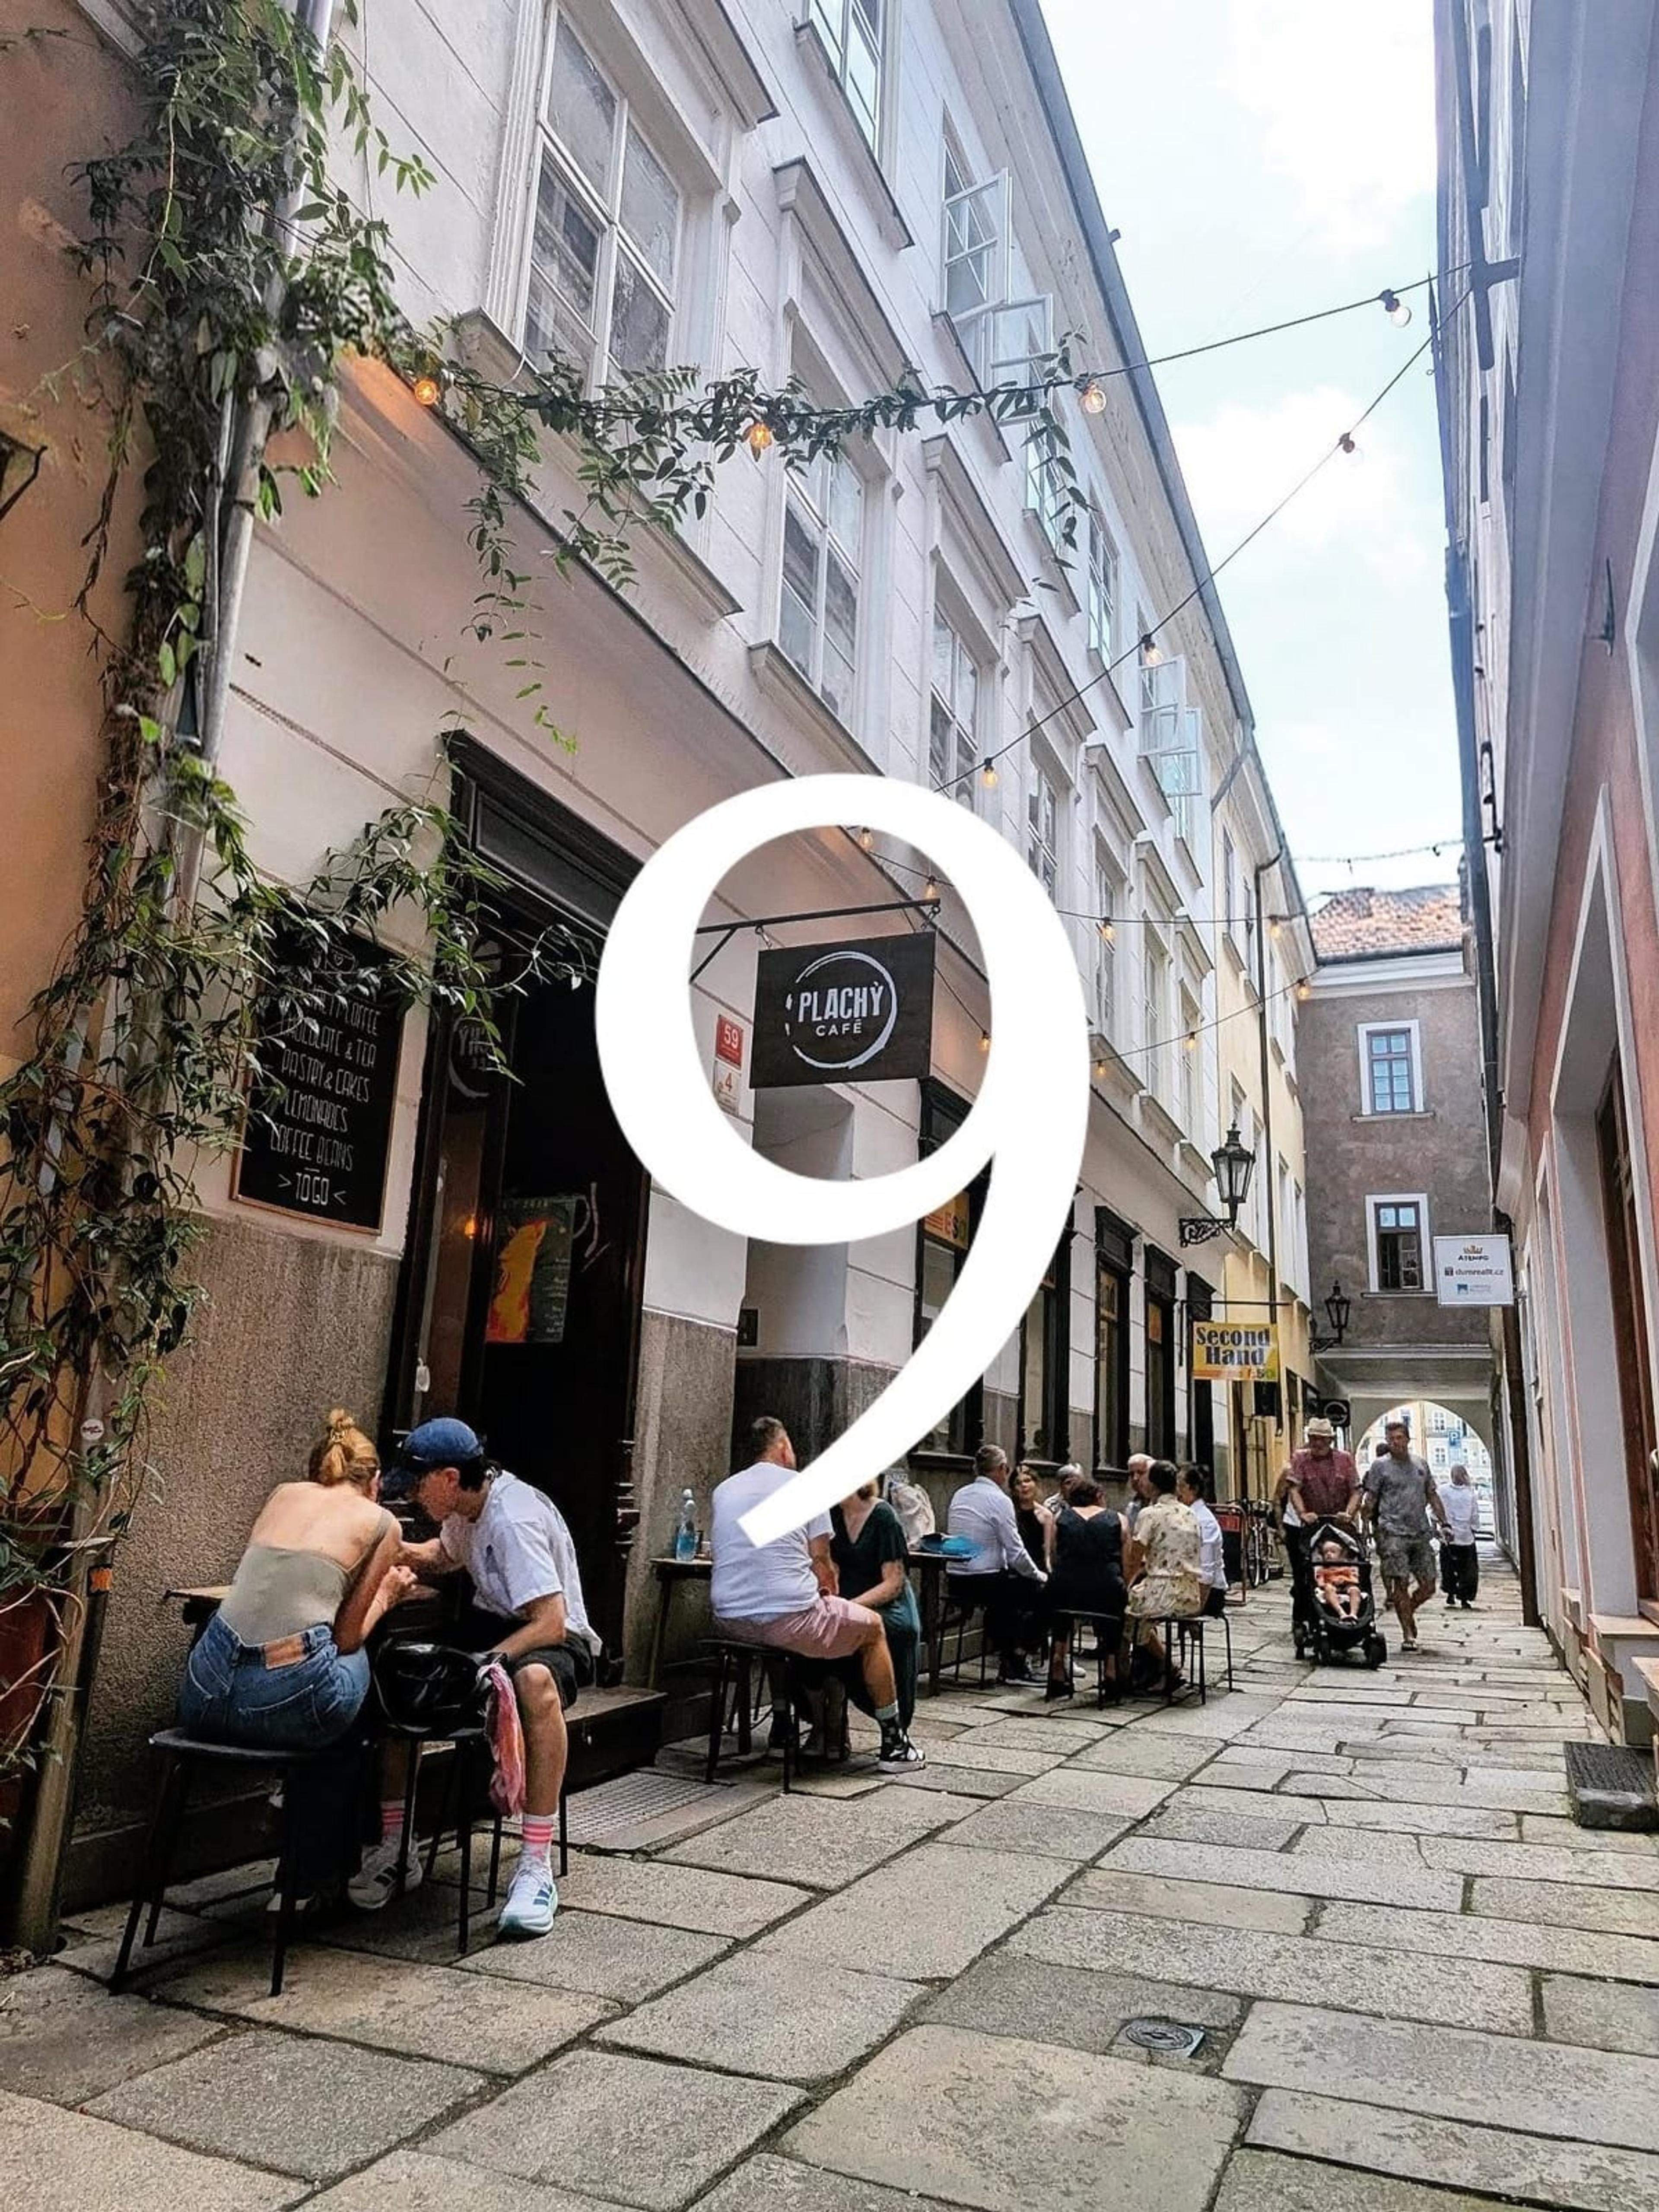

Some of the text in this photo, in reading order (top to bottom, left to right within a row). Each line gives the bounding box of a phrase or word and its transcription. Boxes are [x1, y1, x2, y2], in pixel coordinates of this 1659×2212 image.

[724, 1024, 738, 1049] 59
[815, 1019, 862, 1036] CAFÉ
[356, 1038, 377, 1068] TEA
[281, 1049, 370, 1103] PASTRY & CAKES
[284, 1089, 348, 1133] LEMONADES
[270, 1122, 354, 1171] COFFEE BEANS
[1196, 1326, 1270, 1346] Second
[1205, 1346, 1264, 1365] Hand
[1450, 1432, 1457, 1441] P
